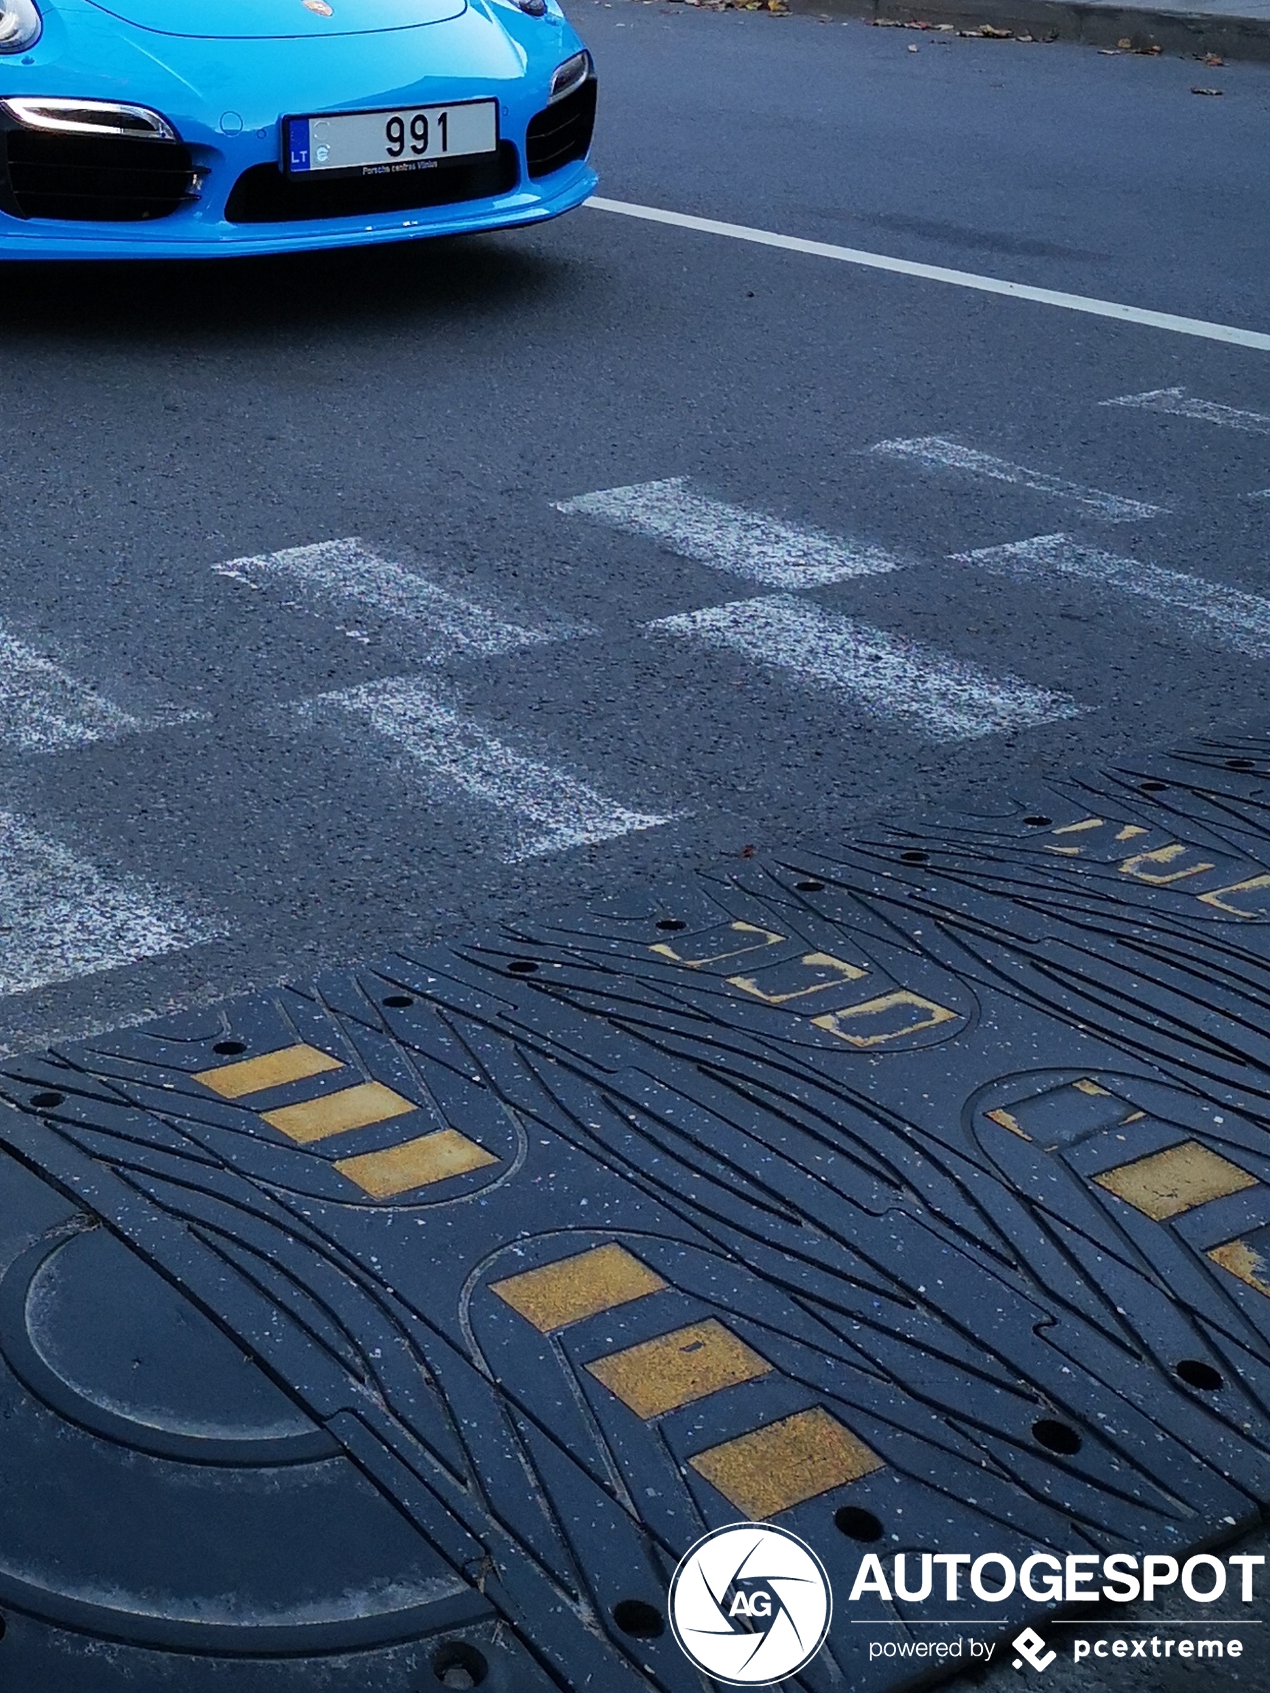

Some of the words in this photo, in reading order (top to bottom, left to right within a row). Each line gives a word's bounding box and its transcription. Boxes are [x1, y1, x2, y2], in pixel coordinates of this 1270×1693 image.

[385, 111, 449, 157] 991
[291, 150, 308, 164] LT
[362, 165, 391, 175] Porsche
